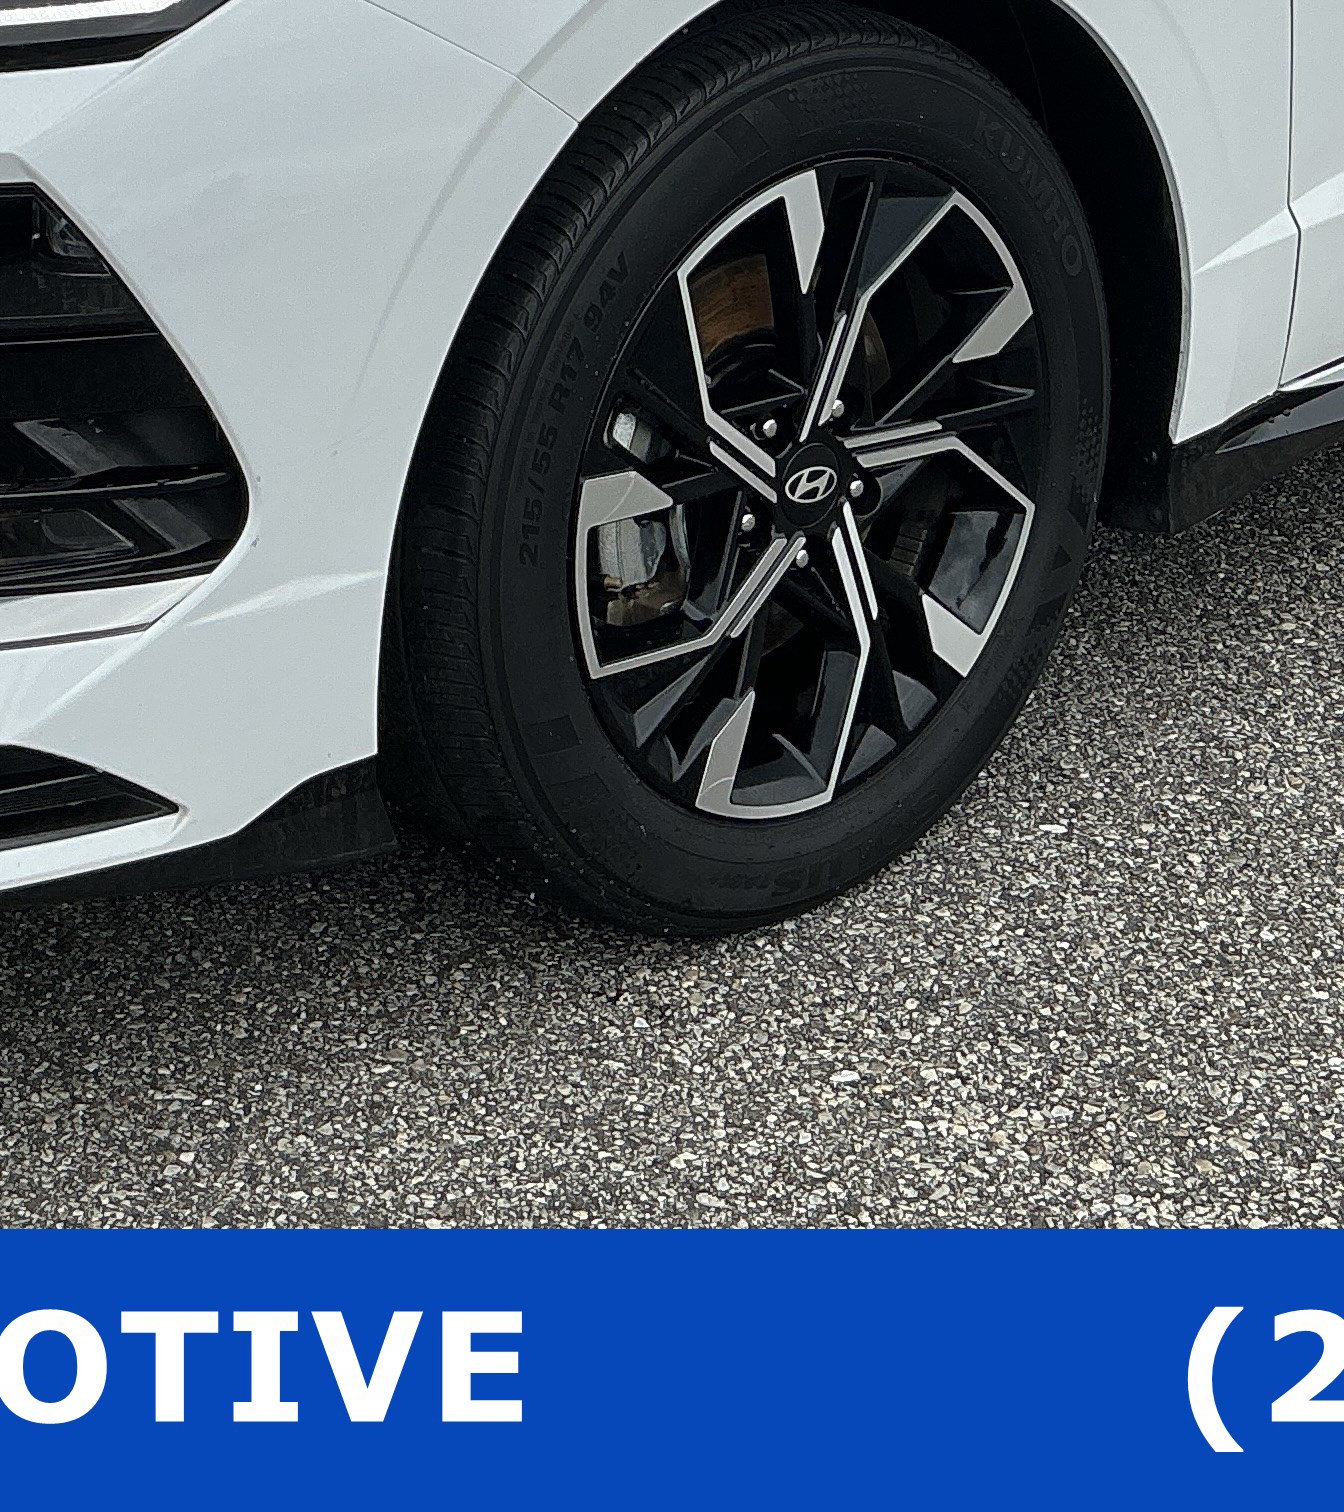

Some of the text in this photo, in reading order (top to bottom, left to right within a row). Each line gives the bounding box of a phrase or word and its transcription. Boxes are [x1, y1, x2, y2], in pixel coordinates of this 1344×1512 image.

[975, 108, 1084, 277] KUMHO
[518, 421, 558, 568] 215/55
[547, 336, 585, 415] R17
[583, 250, 630, 333] 94V
